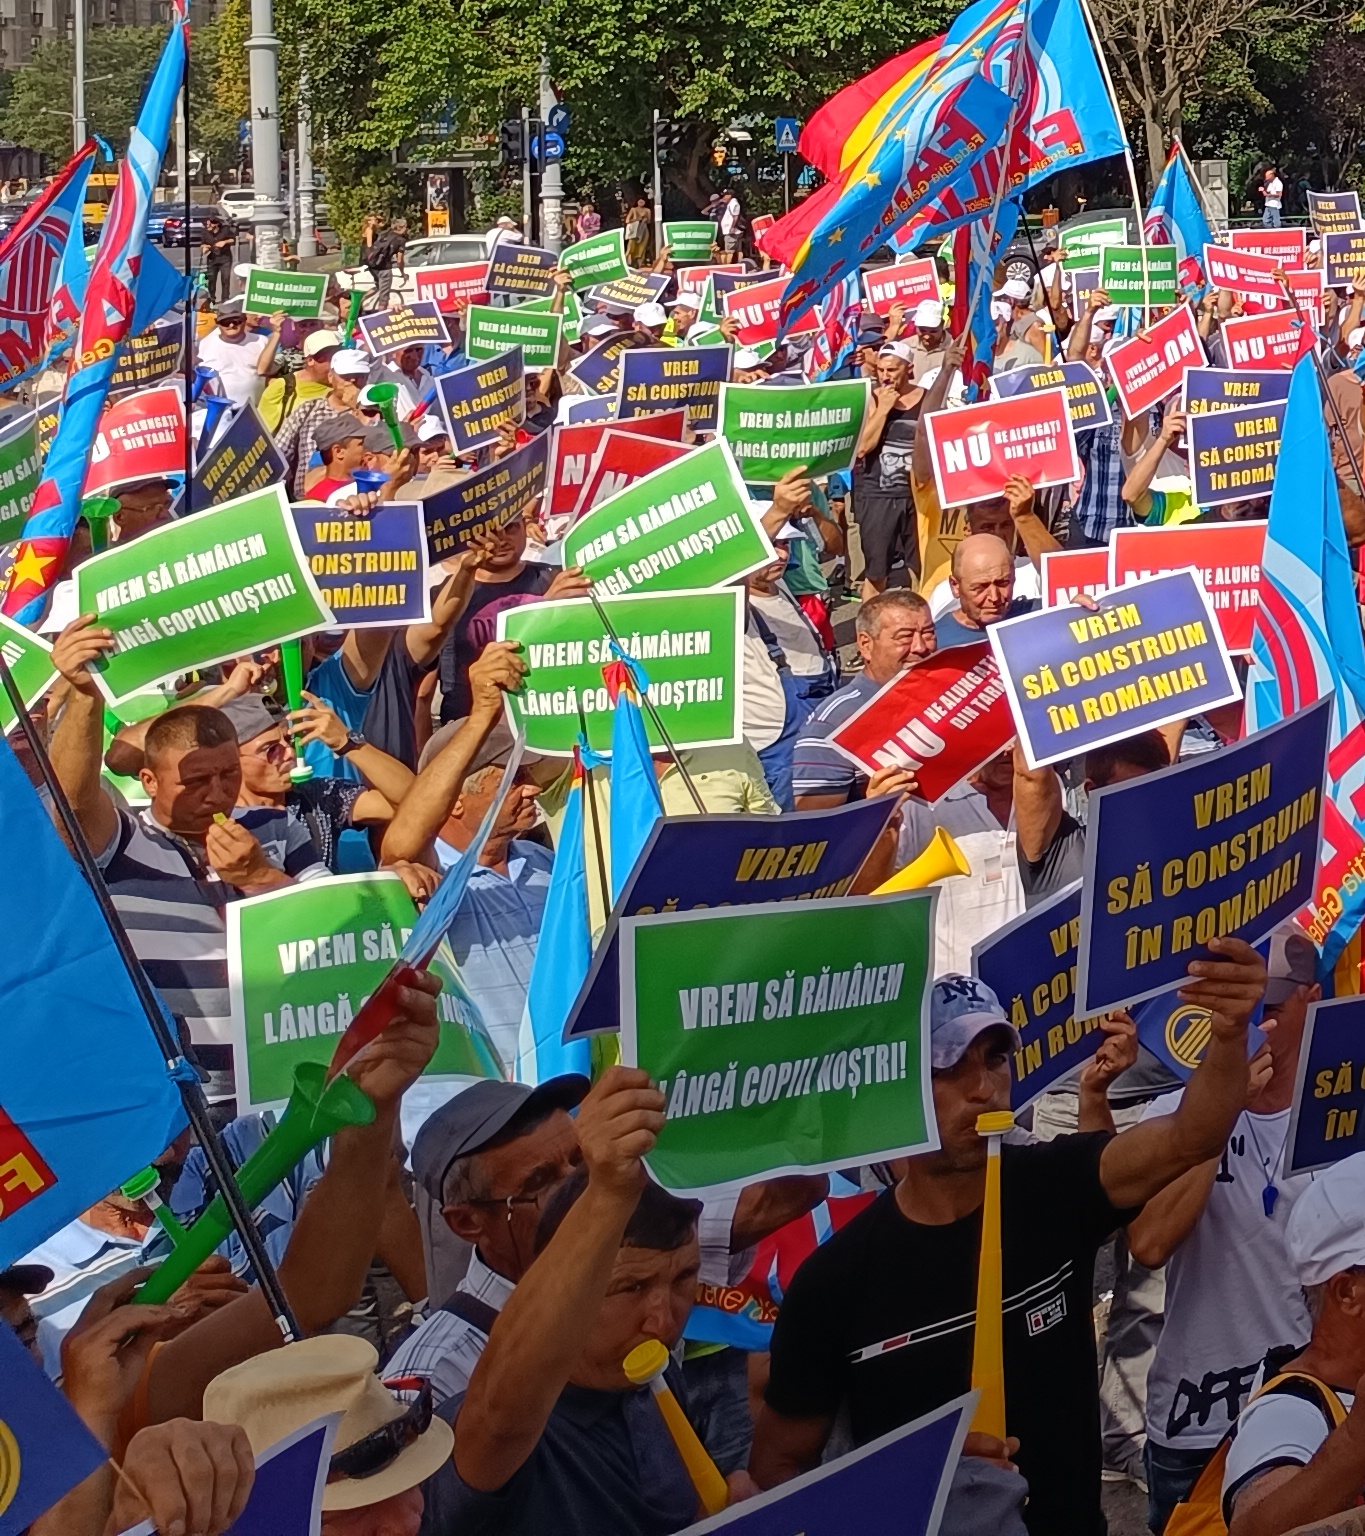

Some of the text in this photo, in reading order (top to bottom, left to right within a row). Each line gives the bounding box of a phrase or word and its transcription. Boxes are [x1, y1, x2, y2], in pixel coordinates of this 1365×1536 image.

[943, 433, 992, 473] NU
[994, 419, 1061, 443] NE ALUNGAȚI
[1004, 438, 1057, 459] DIN ȚARĂ!
[575, 482, 718, 568] VREM SĂ RĂMÂNEM
[629, 513, 744, 587] COPIII NOȘTRI!
[96, 534, 267, 613] VREM SĂ RĂMÂNEM
[164, 595, 218, 639] COPIII
[219, 573, 297, 614] NOȘTRI!
[1069, 604, 1142, 643] VREM
[1023, 621, 1208, 700] SĂ CONSTRUIM
[1047, 662, 1208, 735] ÎN ROMÂNIA!
[1194, 762, 1272, 829] VREM
[1108, 787, 1316, 915] SĂ CONSTRUIM
[1125, 852, 1301, 970] ÎN ROMÂNIA!
[678, 961, 905, 1029] VREM SĂ RĂMÂNEM
[936, 974, 987, 1005] NY
[741, 1053, 816, 1108] COPIII
[818, 1040, 906, 1105] NOȘTRI!
